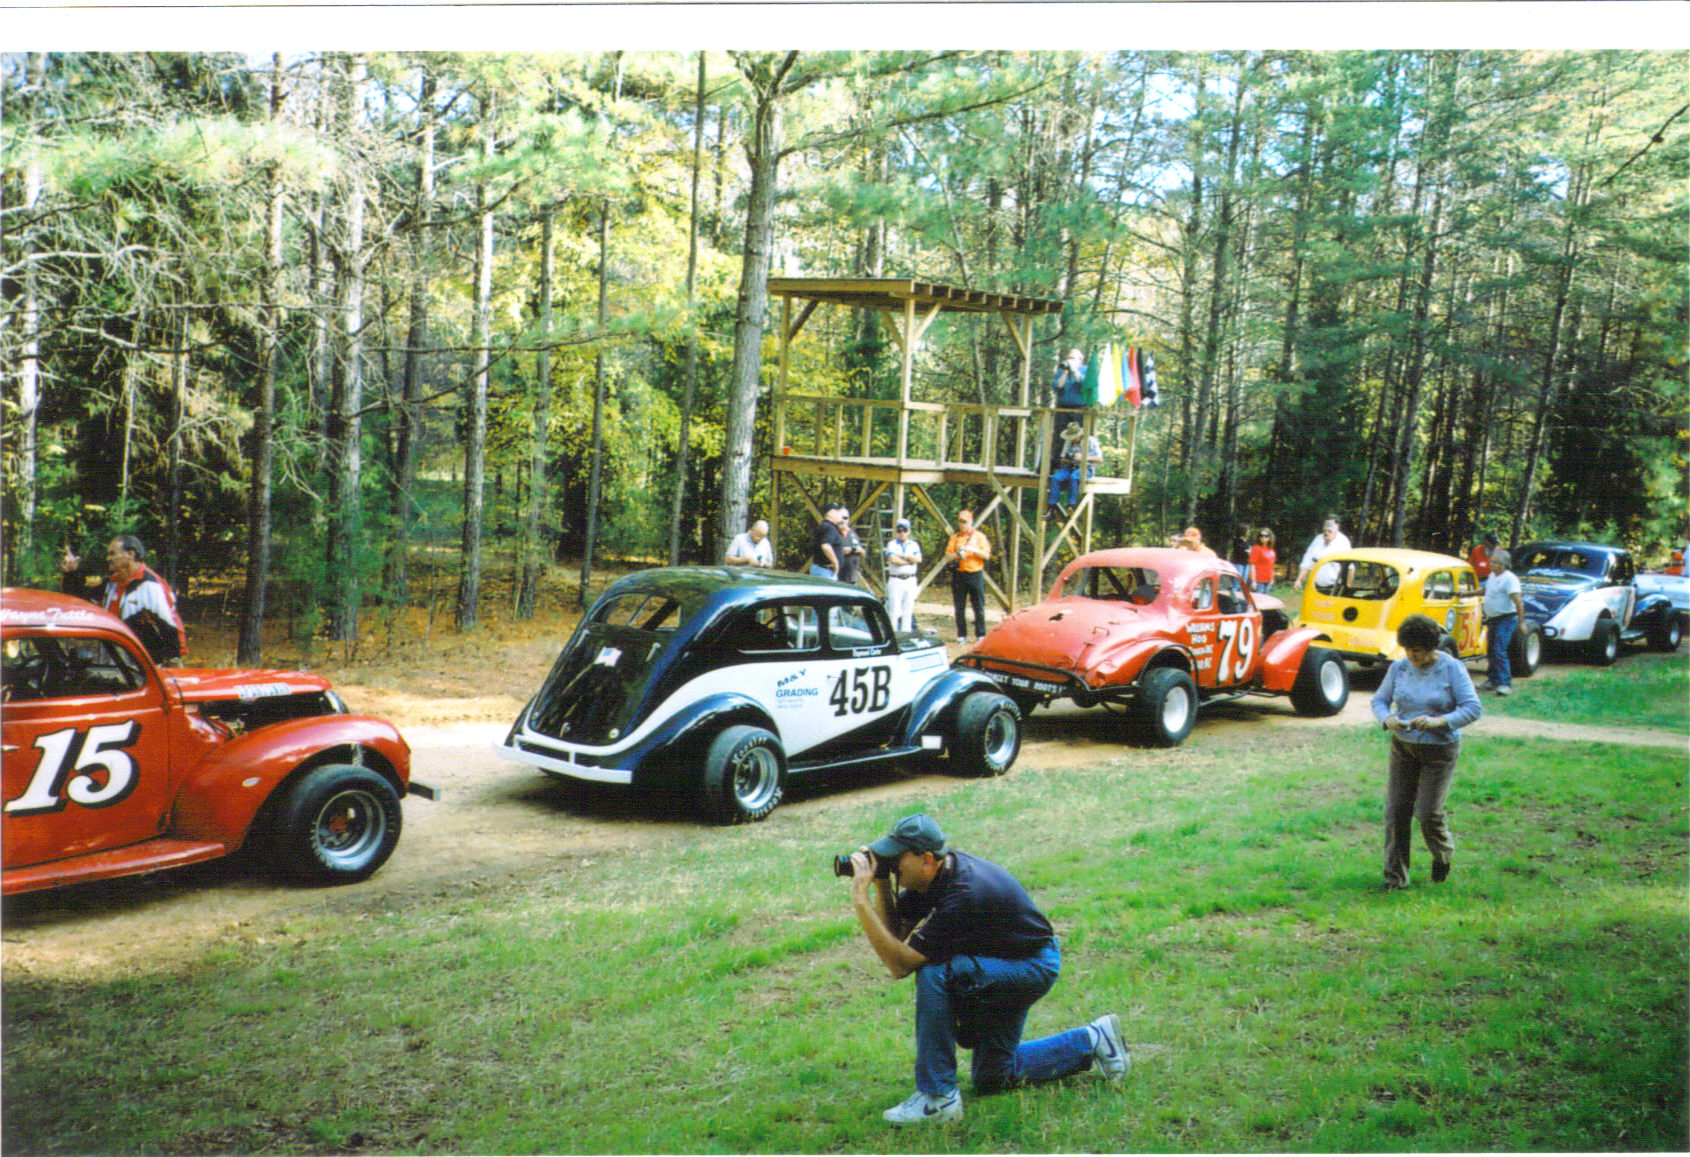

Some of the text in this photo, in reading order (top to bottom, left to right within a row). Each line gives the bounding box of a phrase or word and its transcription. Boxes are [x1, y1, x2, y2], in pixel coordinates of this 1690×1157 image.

[1216, 617, 1254, 685] 79
[776, 687, 818, 698] GRADING
[828, 664, 892, 717] 45B
[3, 719, 142, 818] 15
